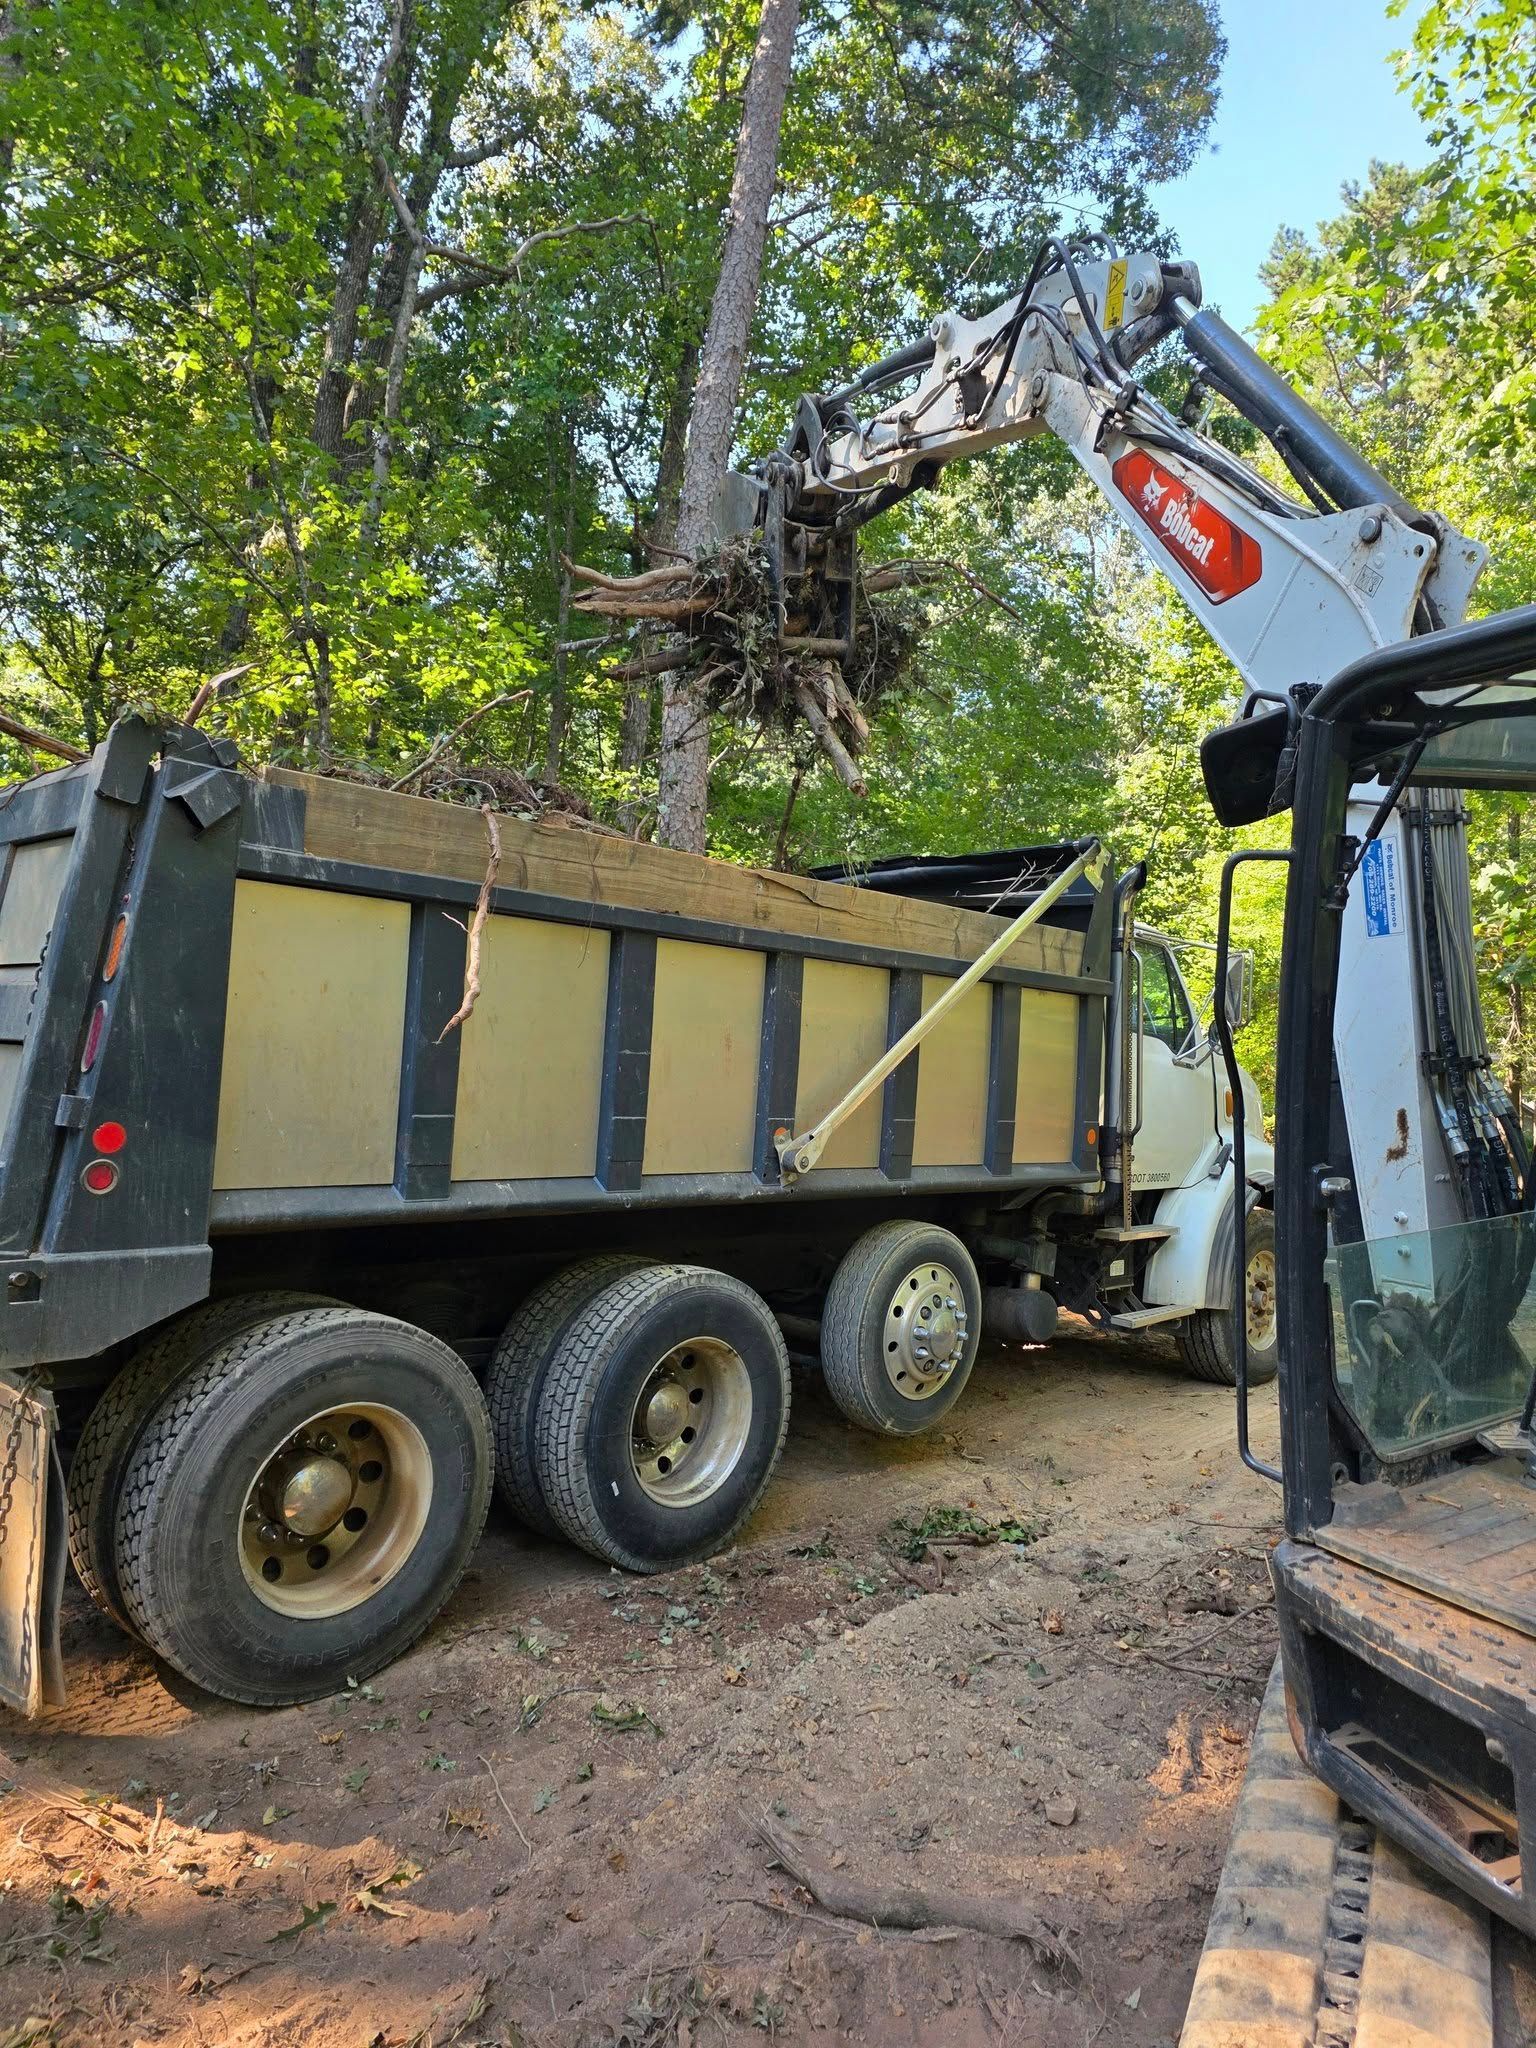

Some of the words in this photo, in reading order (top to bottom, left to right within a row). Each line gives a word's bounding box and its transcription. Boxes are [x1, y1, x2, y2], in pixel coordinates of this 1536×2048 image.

[1160, 498, 1214, 565] Bobcat
[1387, 854, 1395, 880] Bobcat
[1389, 882, 1395, 891] of
